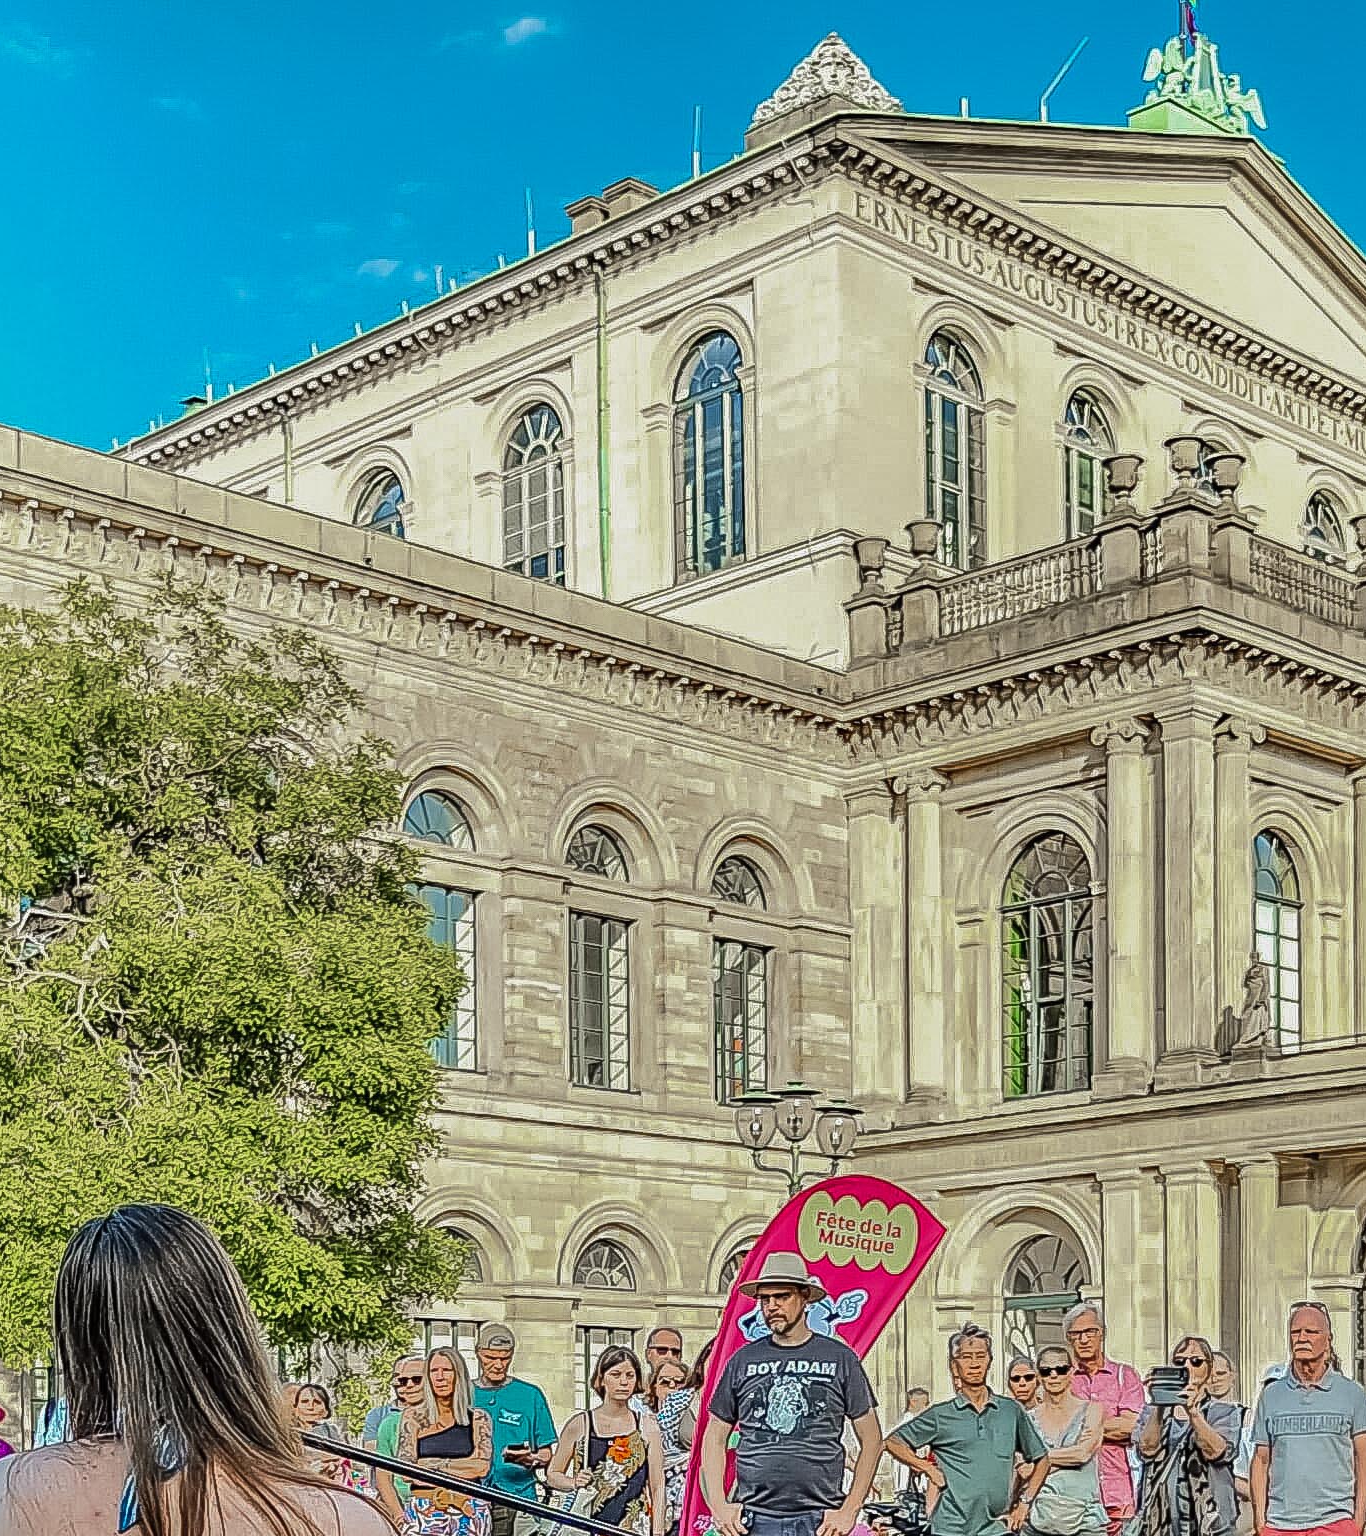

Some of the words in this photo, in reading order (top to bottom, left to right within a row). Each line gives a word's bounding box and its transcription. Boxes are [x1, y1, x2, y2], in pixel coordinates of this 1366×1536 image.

[854, 191, 983, 275] ERNESTUS
[993, 260, 1107, 332] AUGUSTUS
[816, 1211, 856, 1232] Fête
[860, 1219, 882, 1236] de
[887, 1221, 901, 1239] la
[819, 1228, 894, 1254] Musique
[746, 1361, 781, 1377] BOY
[784, 1360, 837, 1376] ADAM
